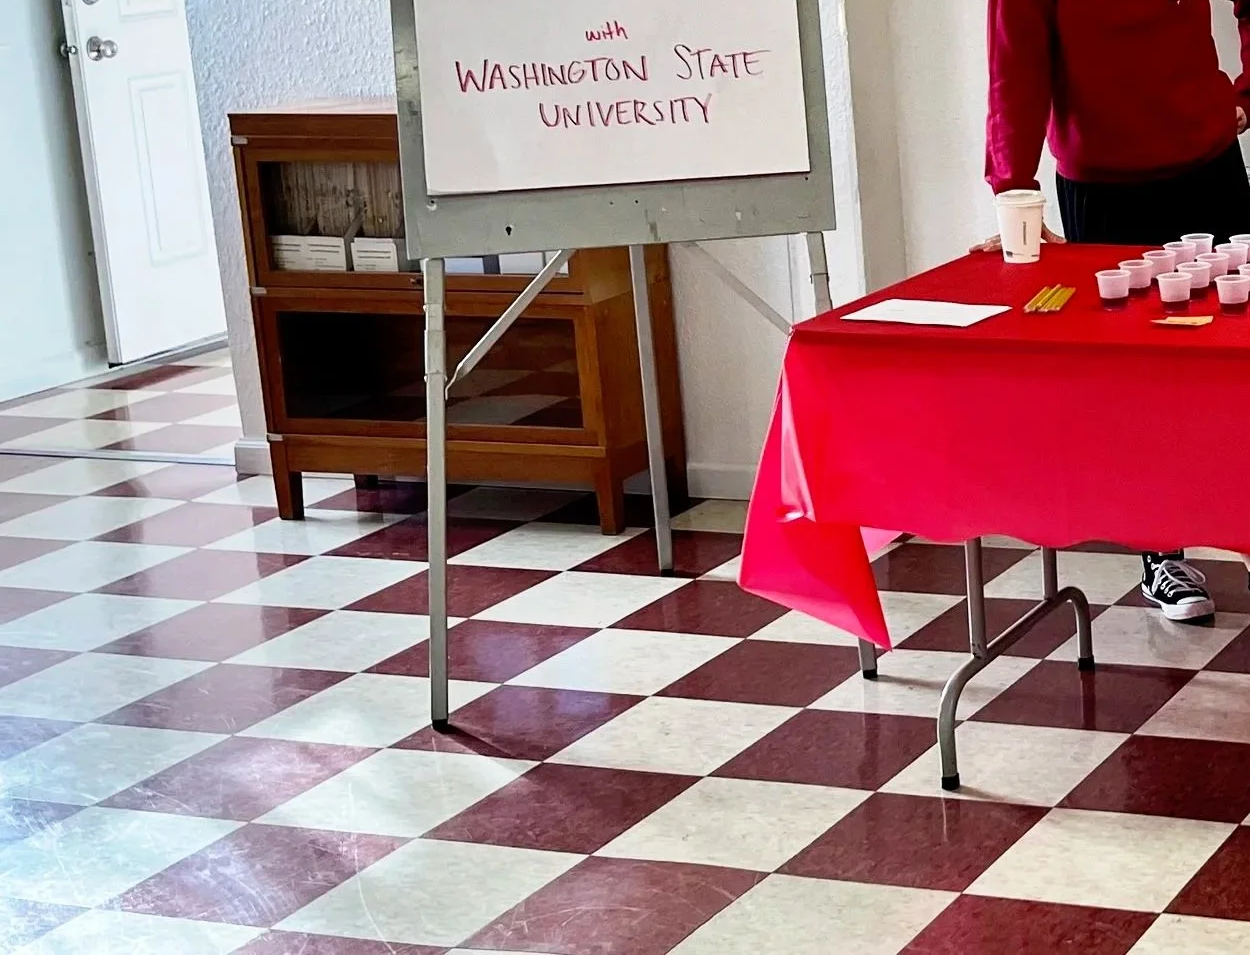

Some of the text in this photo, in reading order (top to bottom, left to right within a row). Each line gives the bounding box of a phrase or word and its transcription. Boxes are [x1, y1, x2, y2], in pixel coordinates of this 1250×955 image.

[586, 19, 629, 42] with
[455, 44, 771, 93] WASHINGTON STATE
[539, 93, 713, 129] UNIVERSITY
